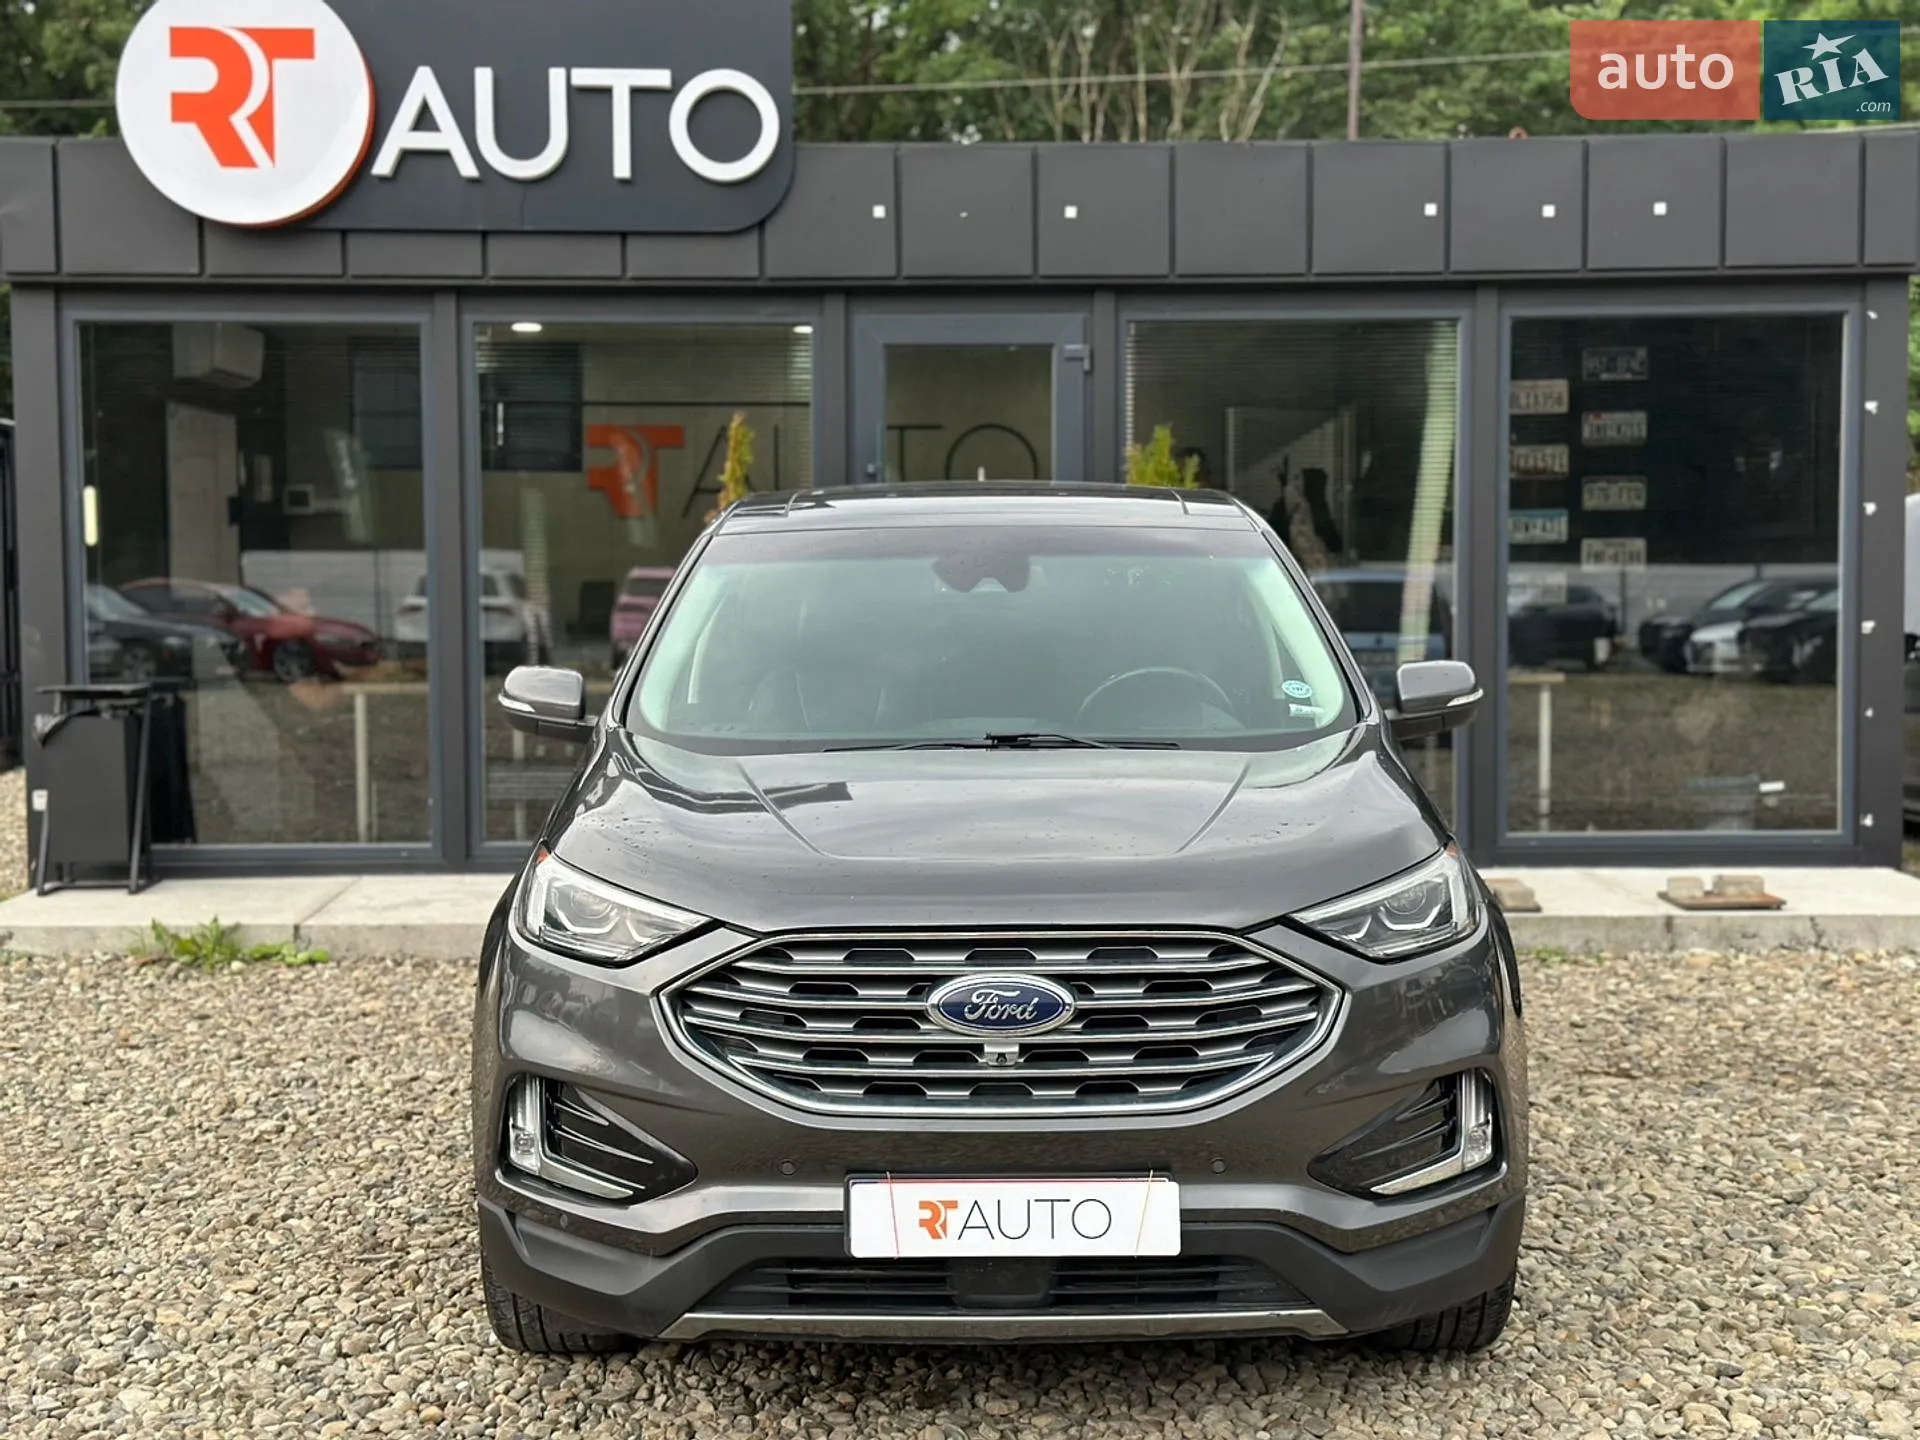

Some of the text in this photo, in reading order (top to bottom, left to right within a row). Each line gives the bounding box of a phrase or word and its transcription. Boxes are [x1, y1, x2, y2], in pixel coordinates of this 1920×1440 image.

[170, 26, 780, 183] RT AUTO
[964, 988, 1040, 1022] Ford
[918, 1198, 1112, 1240] RT AUTO
